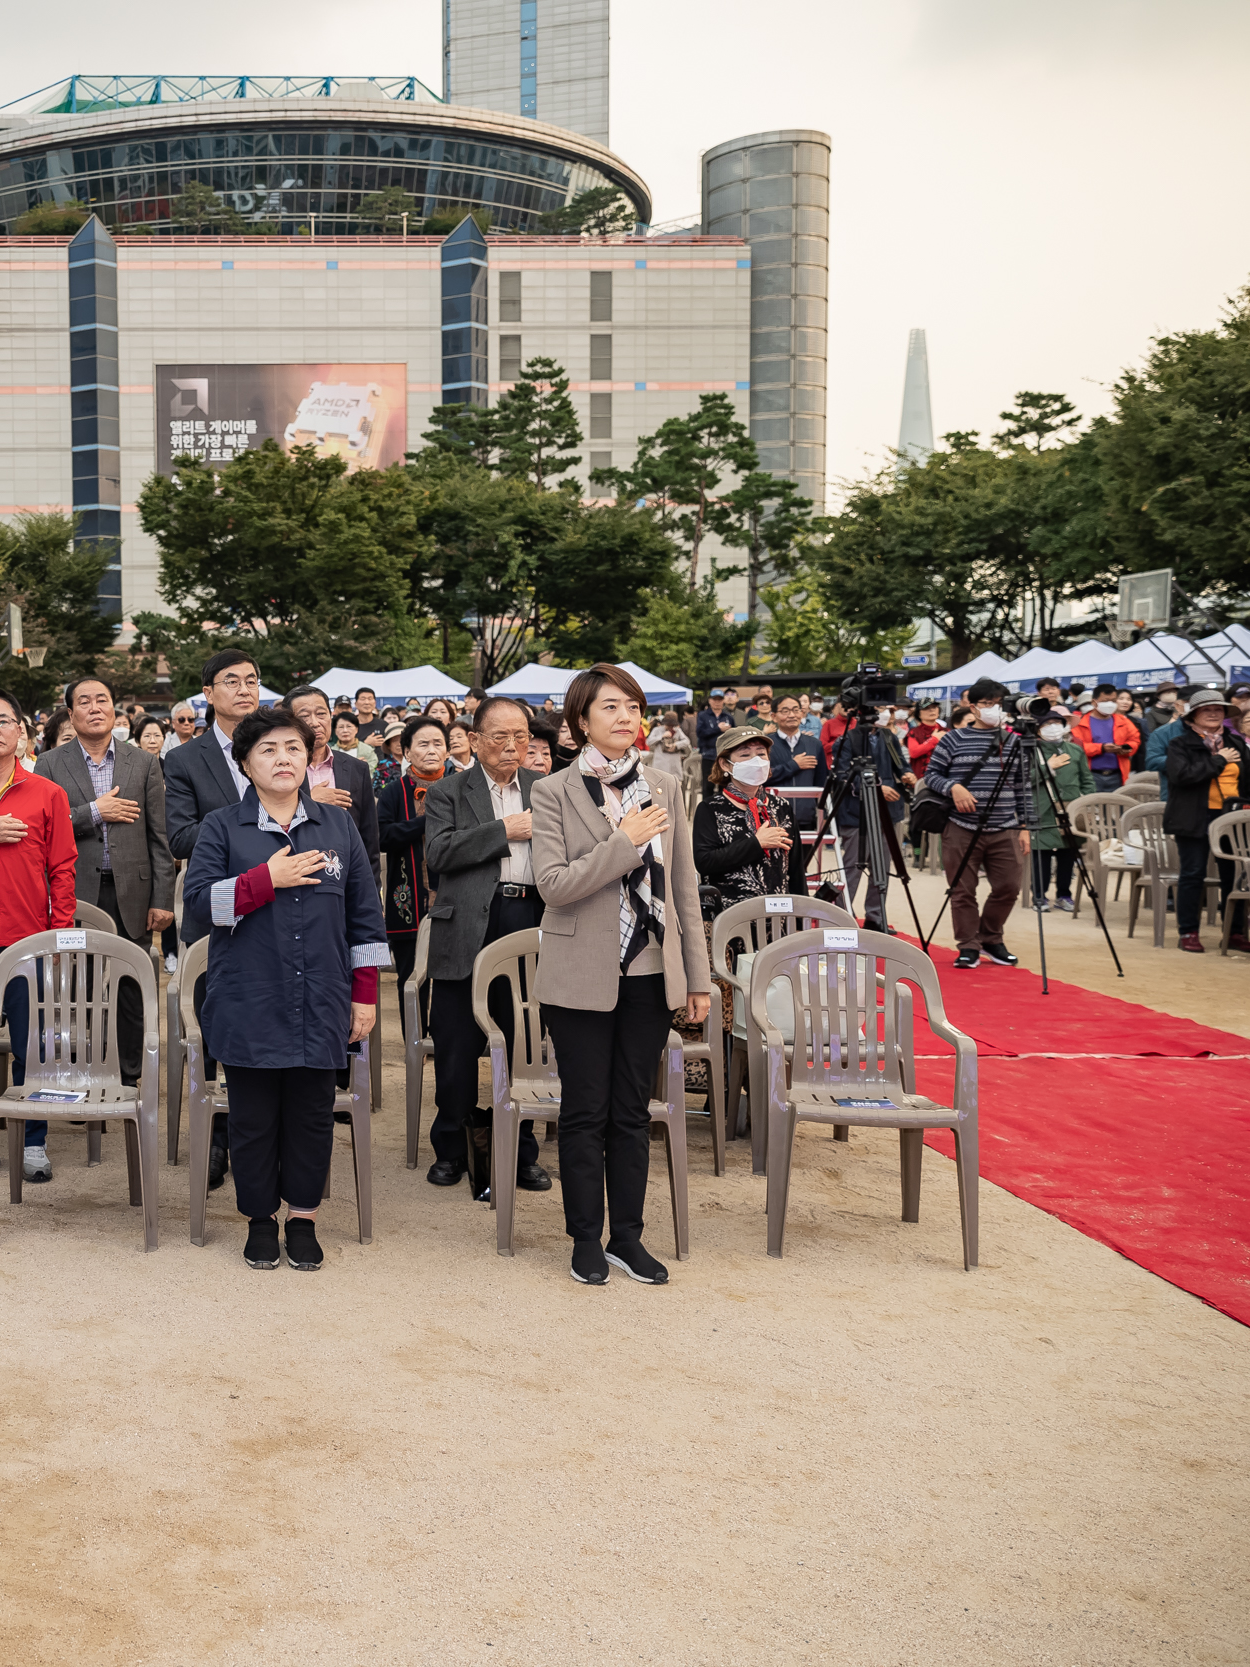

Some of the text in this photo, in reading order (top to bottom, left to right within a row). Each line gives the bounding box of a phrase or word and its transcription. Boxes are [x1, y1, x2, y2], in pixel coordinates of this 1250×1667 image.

[311, 398, 346, 408] AMD
[306, 408, 351, 418] RYZEN
[209, 419, 257, 434] 게이머를
[170, 434, 249, 448] 위한 가장 빠른
